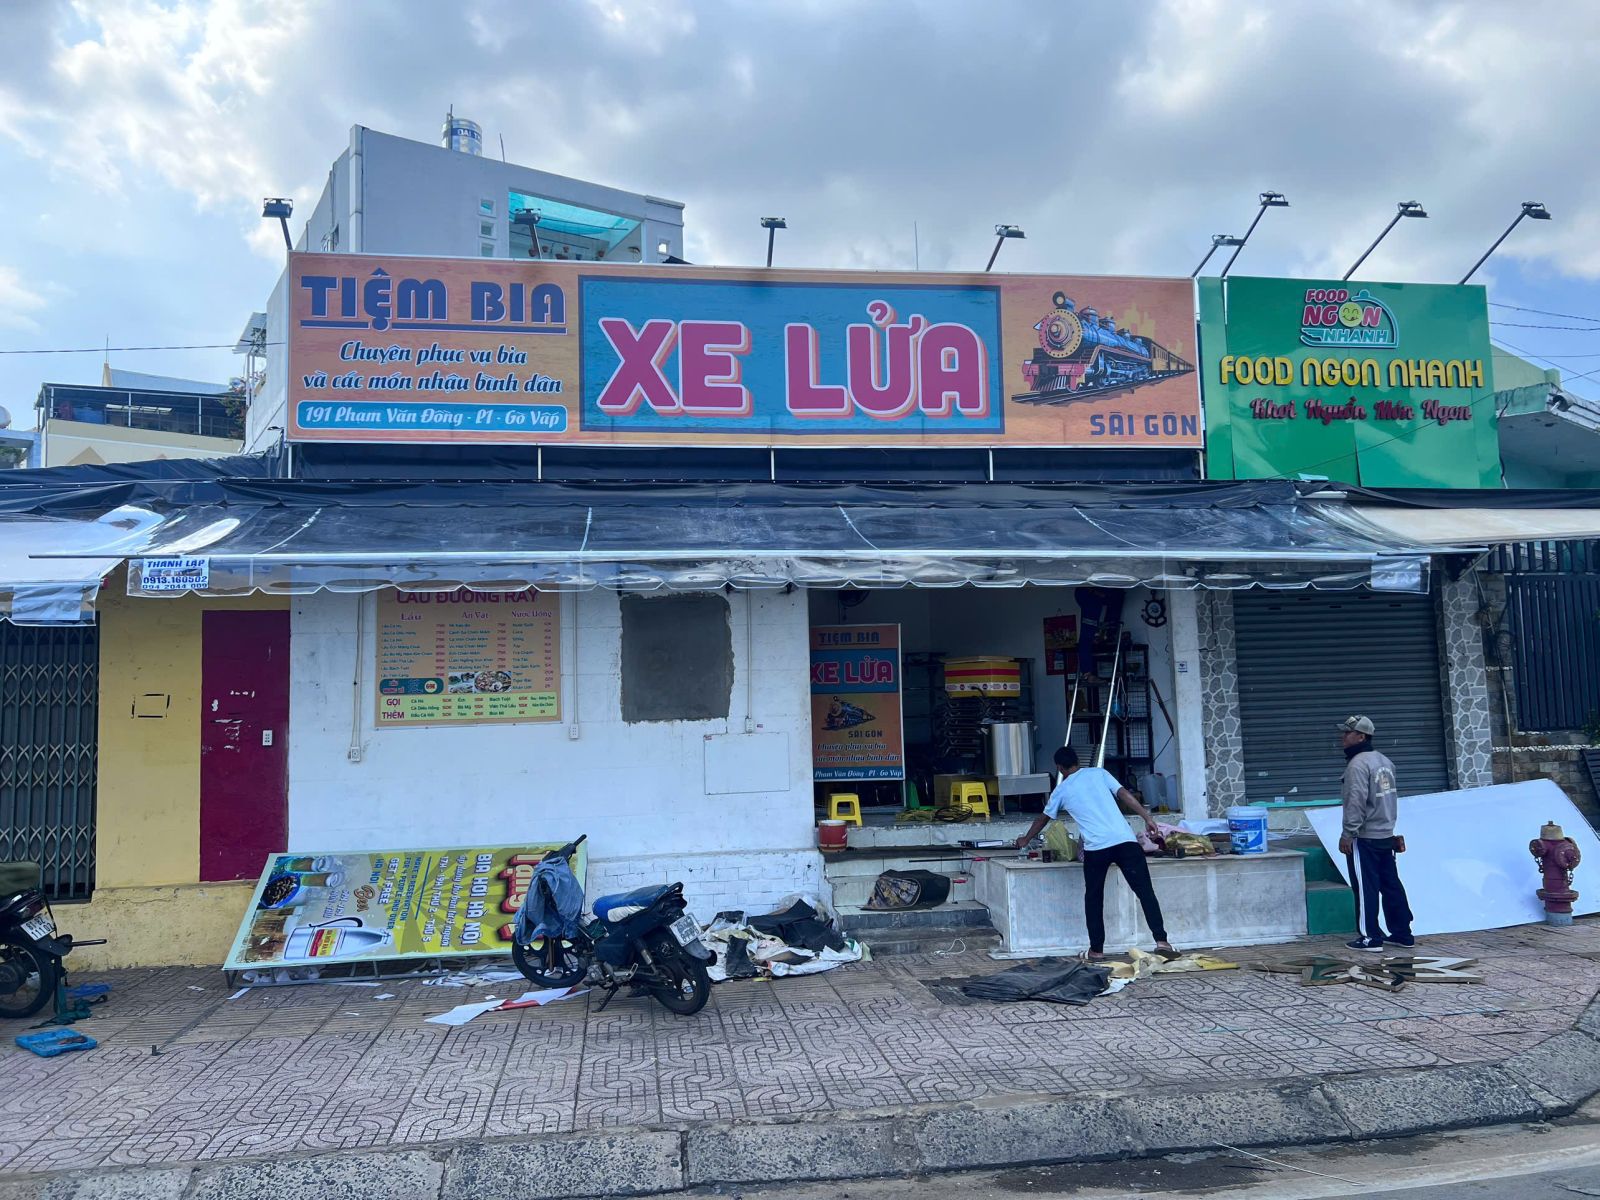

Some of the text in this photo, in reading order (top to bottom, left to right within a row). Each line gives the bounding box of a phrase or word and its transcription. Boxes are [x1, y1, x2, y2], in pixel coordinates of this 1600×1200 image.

[301, 267, 565, 331] TIỆM BIA
[1305, 288, 1349, 303] FOOD
[1322, 329, 1388, 343] NHANH
[340, 341, 527, 367] Chuyên phục vụ bia
[596, 300, 991, 419] XE LỬA
[303, 370, 562, 393] và các món nhậu bình dân
[1220, 355, 1484, 388] FOOD NGON NHANH
[305, 406, 332, 423] 191
[386, 407, 417, 423] Văn
[420, 408, 463, 427] Đồng
[505, 410, 527, 425] Gò
[530, 410, 560, 428] Vấp
[844, 656, 894, 684] LỬA
[388, 857, 399, 873] GET
[474, 853, 493, 873] BIA
[378, 882, 394, 905] FREE
[466, 900, 489, 919] HÀ
[458, 921, 483, 945] NỘI
